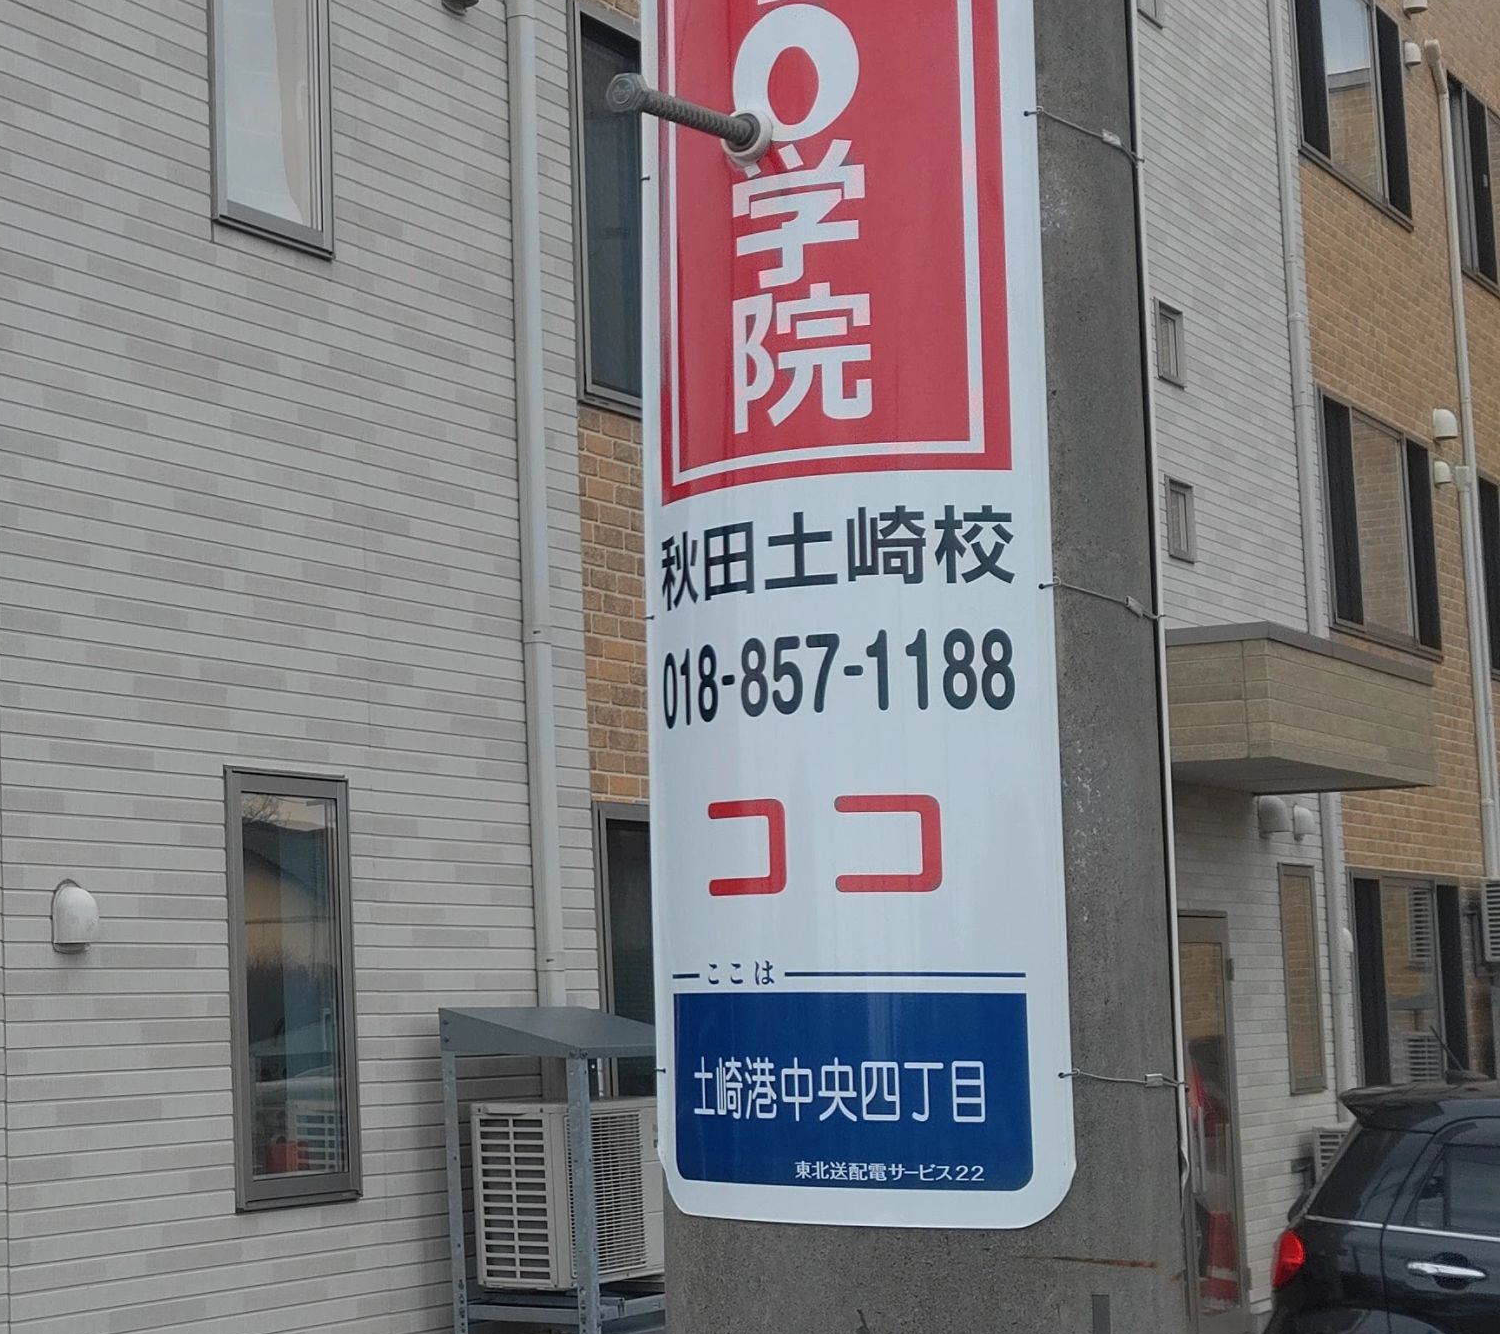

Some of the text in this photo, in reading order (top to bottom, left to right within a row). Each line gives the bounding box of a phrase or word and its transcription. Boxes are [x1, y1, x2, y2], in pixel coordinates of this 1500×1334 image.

[661, 504, 1016, 612] 秋田土崎校
[662, 628, 1016, 730] 018-857-1188
[706, 793, 942, 898] ココ
[706, 960, 776, 986] ここは
[693, 1056, 987, 1123] 土崎港中央四丁目
[794, 1160, 986, 1182] 東北送配電サービス22
